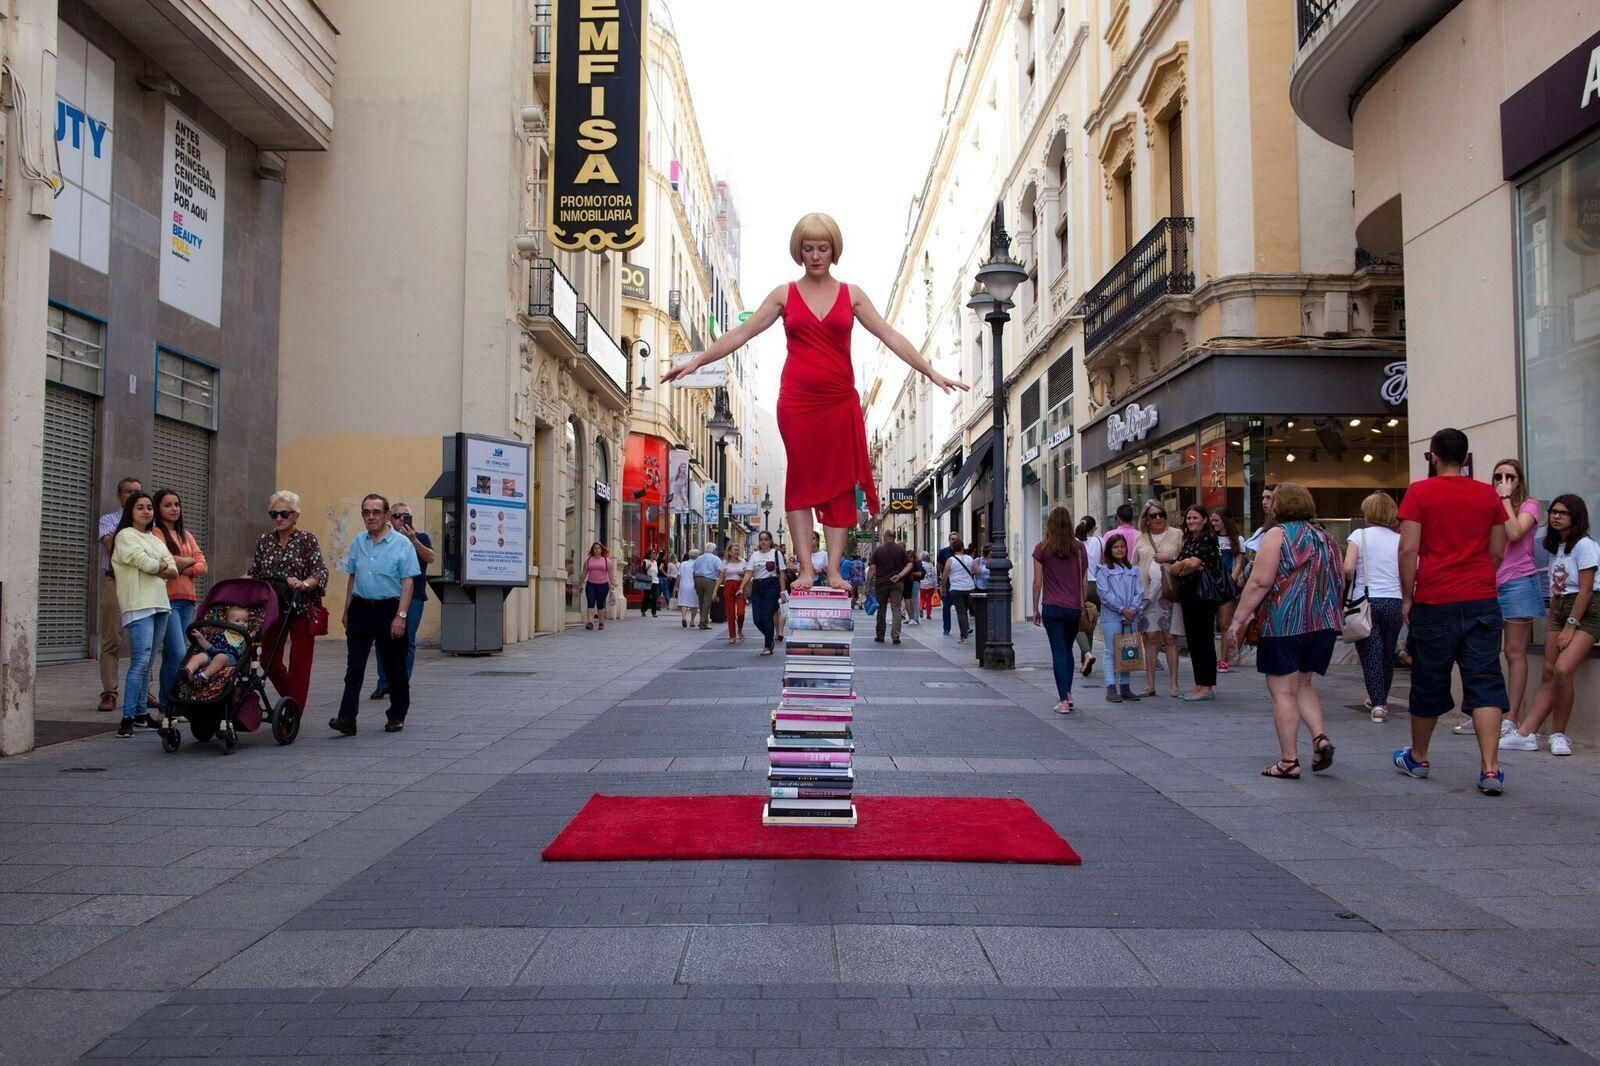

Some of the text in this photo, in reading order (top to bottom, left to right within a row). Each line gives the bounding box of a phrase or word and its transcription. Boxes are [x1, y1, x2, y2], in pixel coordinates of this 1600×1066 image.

[175, 119, 200, 146] ANTES
[175, 133, 201, 161] DE SER
[175, 148, 212, 185] PRINCESA,
[174, 163, 216, 200] CENICIENTA
[174, 177, 193, 198] VINO
[174, 192, 189, 211] POR
[560, 195, 632, 207] PROMOTORA
[173, 210, 184, 226] BE
[560, 209, 632, 222] INMOBILIARIA
[171, 236, 190, 256] FULL
[172, 223, 203, 249] BEAUTY
[797, 609, 840, 618] ART NOW
